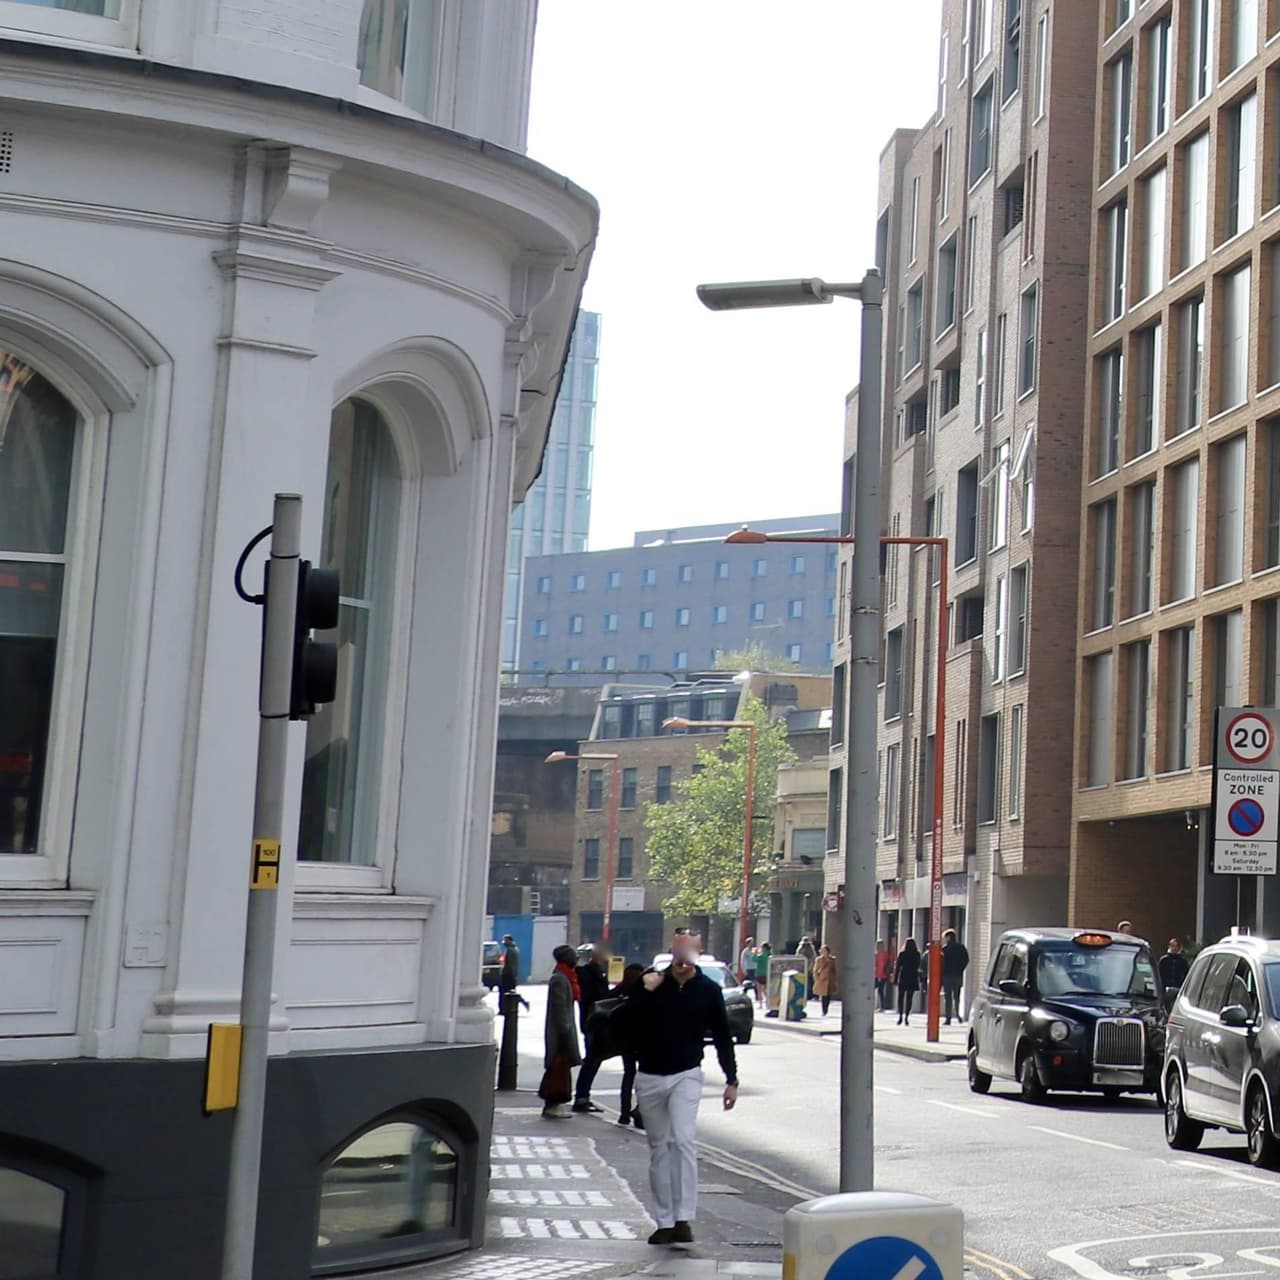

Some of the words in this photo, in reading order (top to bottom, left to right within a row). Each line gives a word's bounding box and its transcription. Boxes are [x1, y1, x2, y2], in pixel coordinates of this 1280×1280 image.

[1234, 728, 1267, 748] 20
[1223, 773, 1274, 783] Controlled
[1229, 784, 1265, 795] ZONE
